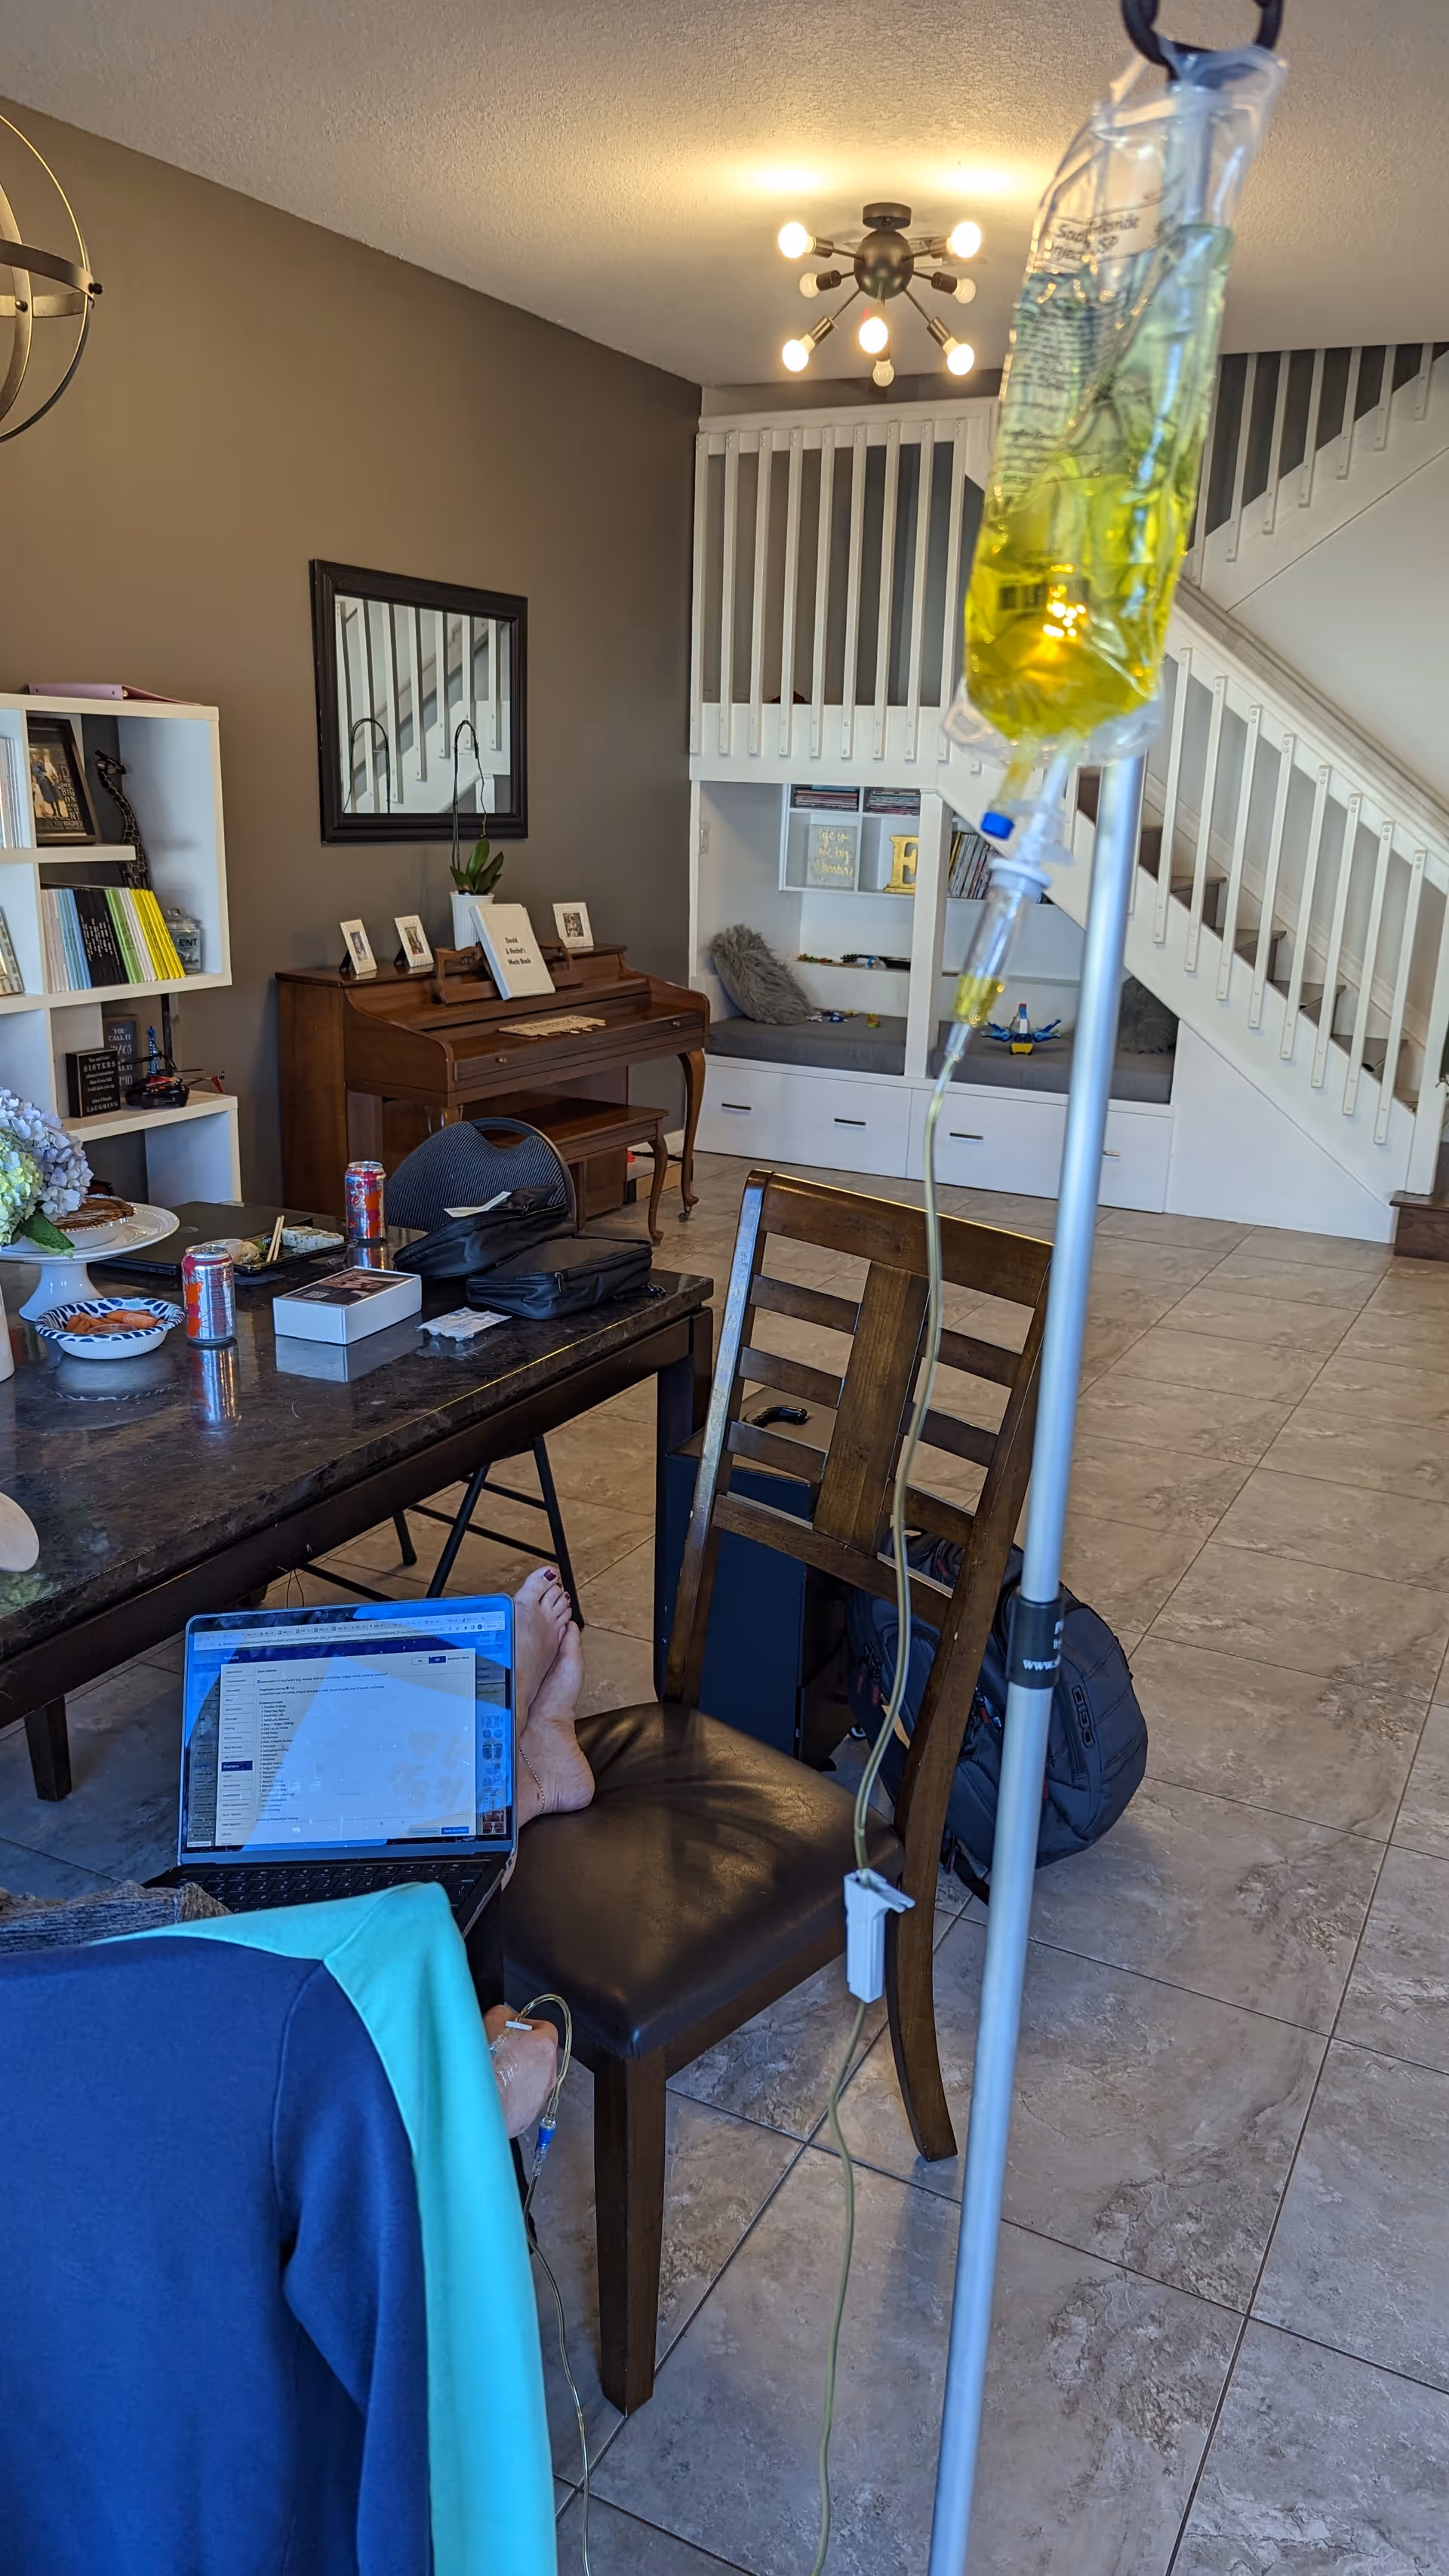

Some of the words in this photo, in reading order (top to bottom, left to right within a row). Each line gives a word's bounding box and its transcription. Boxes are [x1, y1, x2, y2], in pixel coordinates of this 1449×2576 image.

[61, 787, 75, 796] BIG
[84, 1060, 115, 1072] SISTERS
[86, 1102, 118, 1112] LAUGHING
